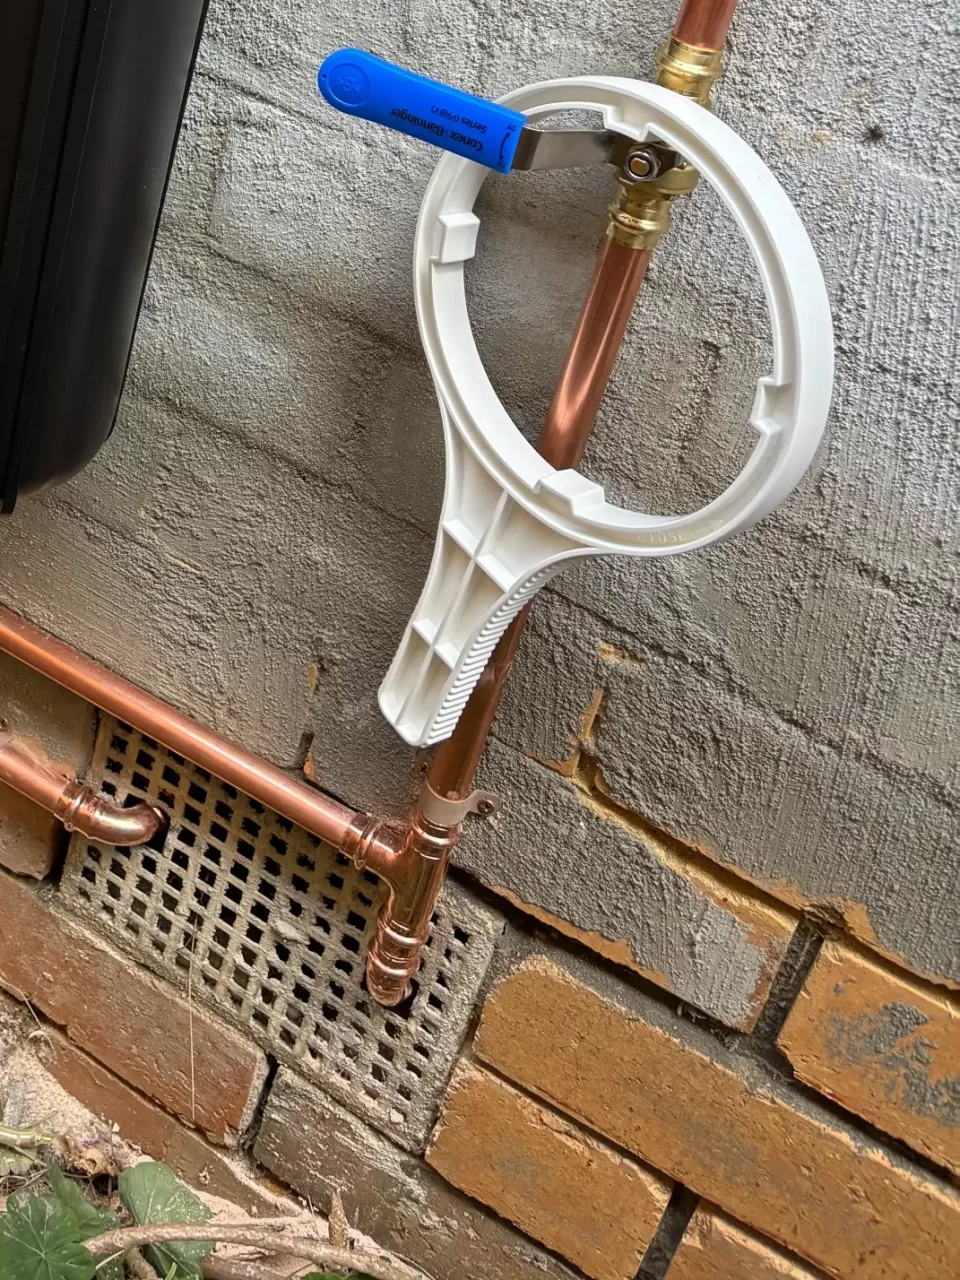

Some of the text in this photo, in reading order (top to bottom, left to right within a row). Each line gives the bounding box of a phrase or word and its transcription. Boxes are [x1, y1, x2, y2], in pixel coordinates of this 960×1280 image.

[390, 108, 484, 152] Conex Bänninger
[461, 120, 488, 134] Series
